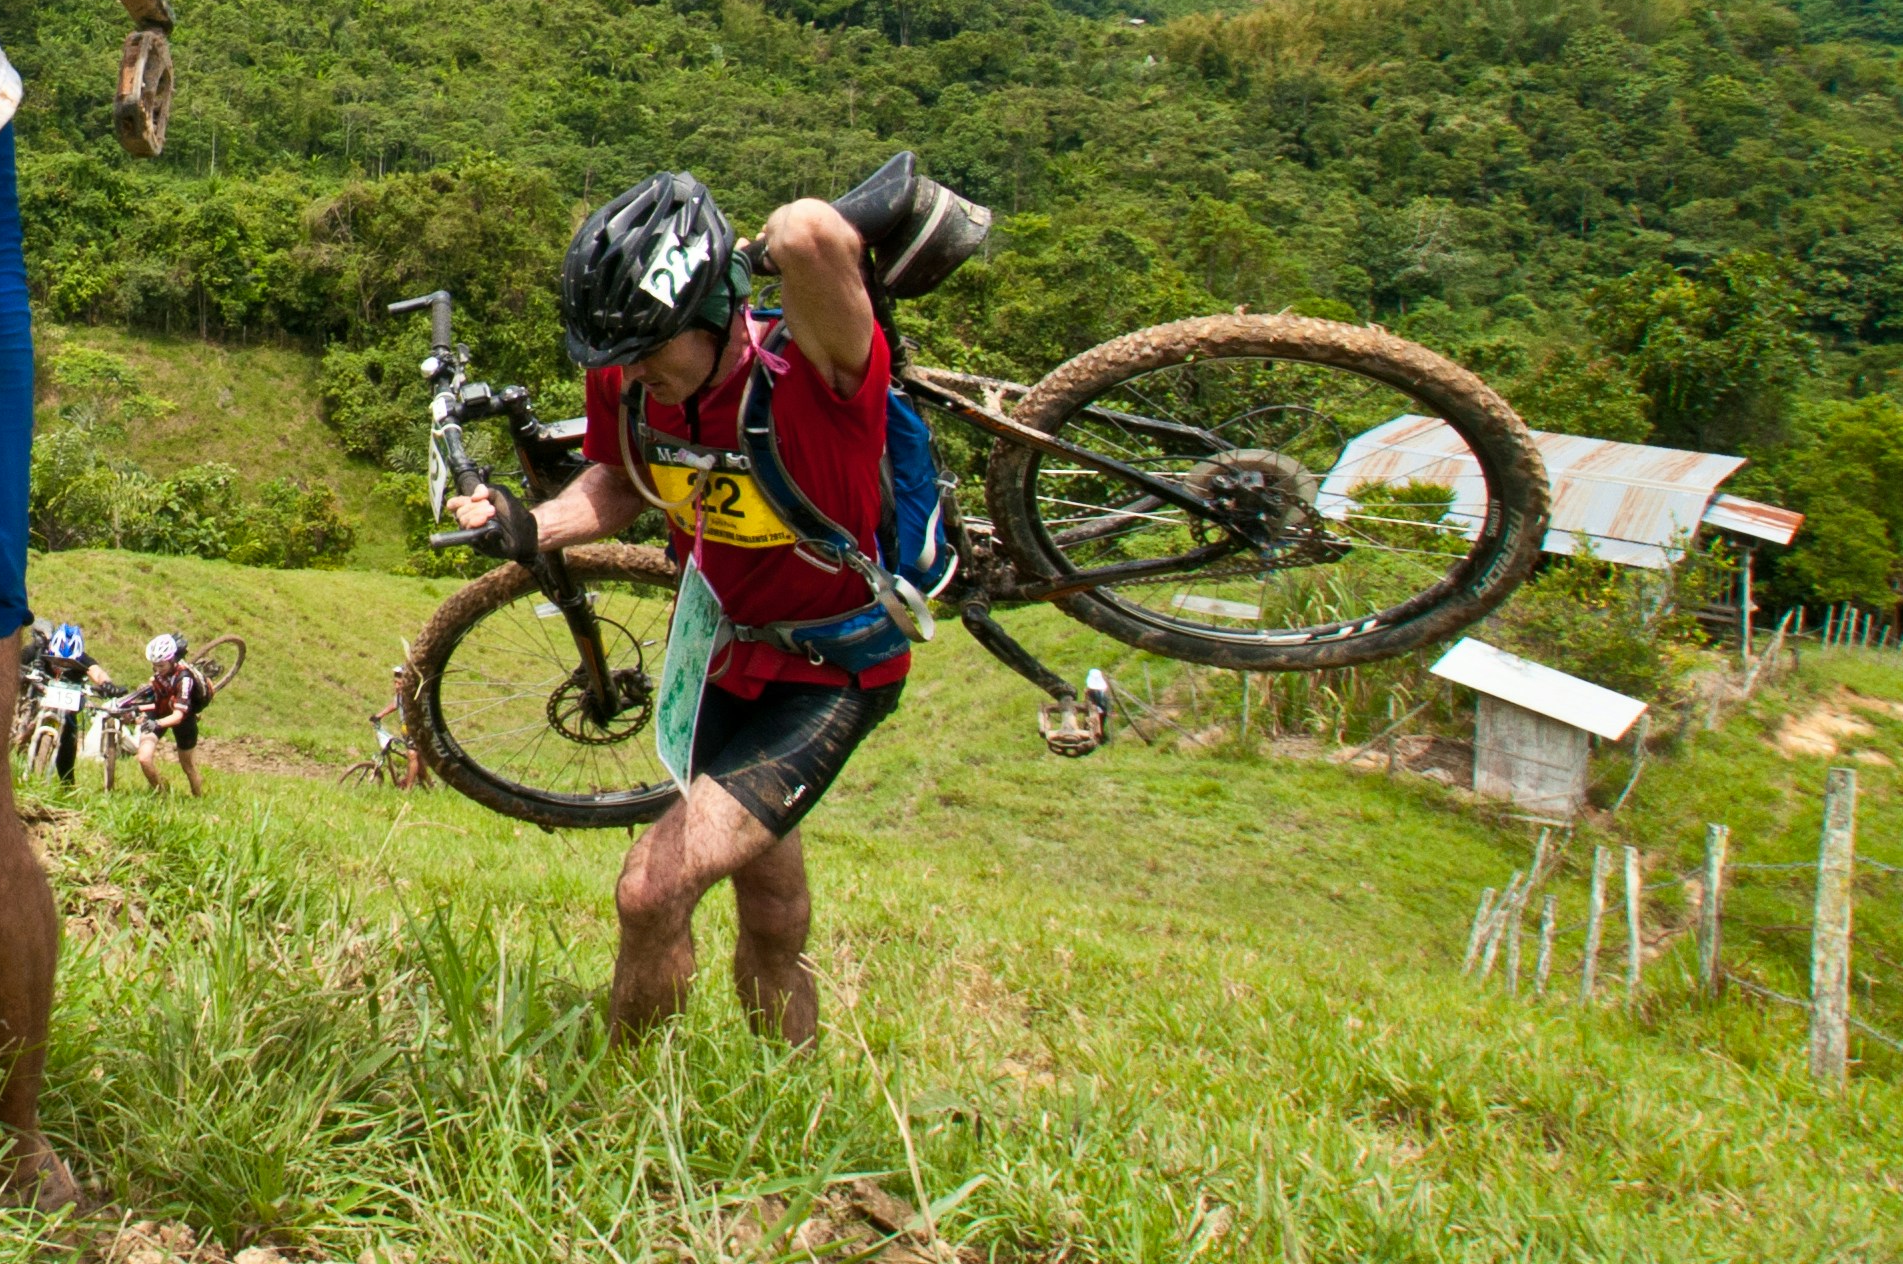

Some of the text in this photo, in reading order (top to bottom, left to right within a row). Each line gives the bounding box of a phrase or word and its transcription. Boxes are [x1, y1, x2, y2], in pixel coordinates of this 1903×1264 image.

[650, 244, 694, 306] 22
[687, 472, 746, 519] 22
[1471, 507, 1525, 599] MERIDA
[56, 691, 74, 706] 15
